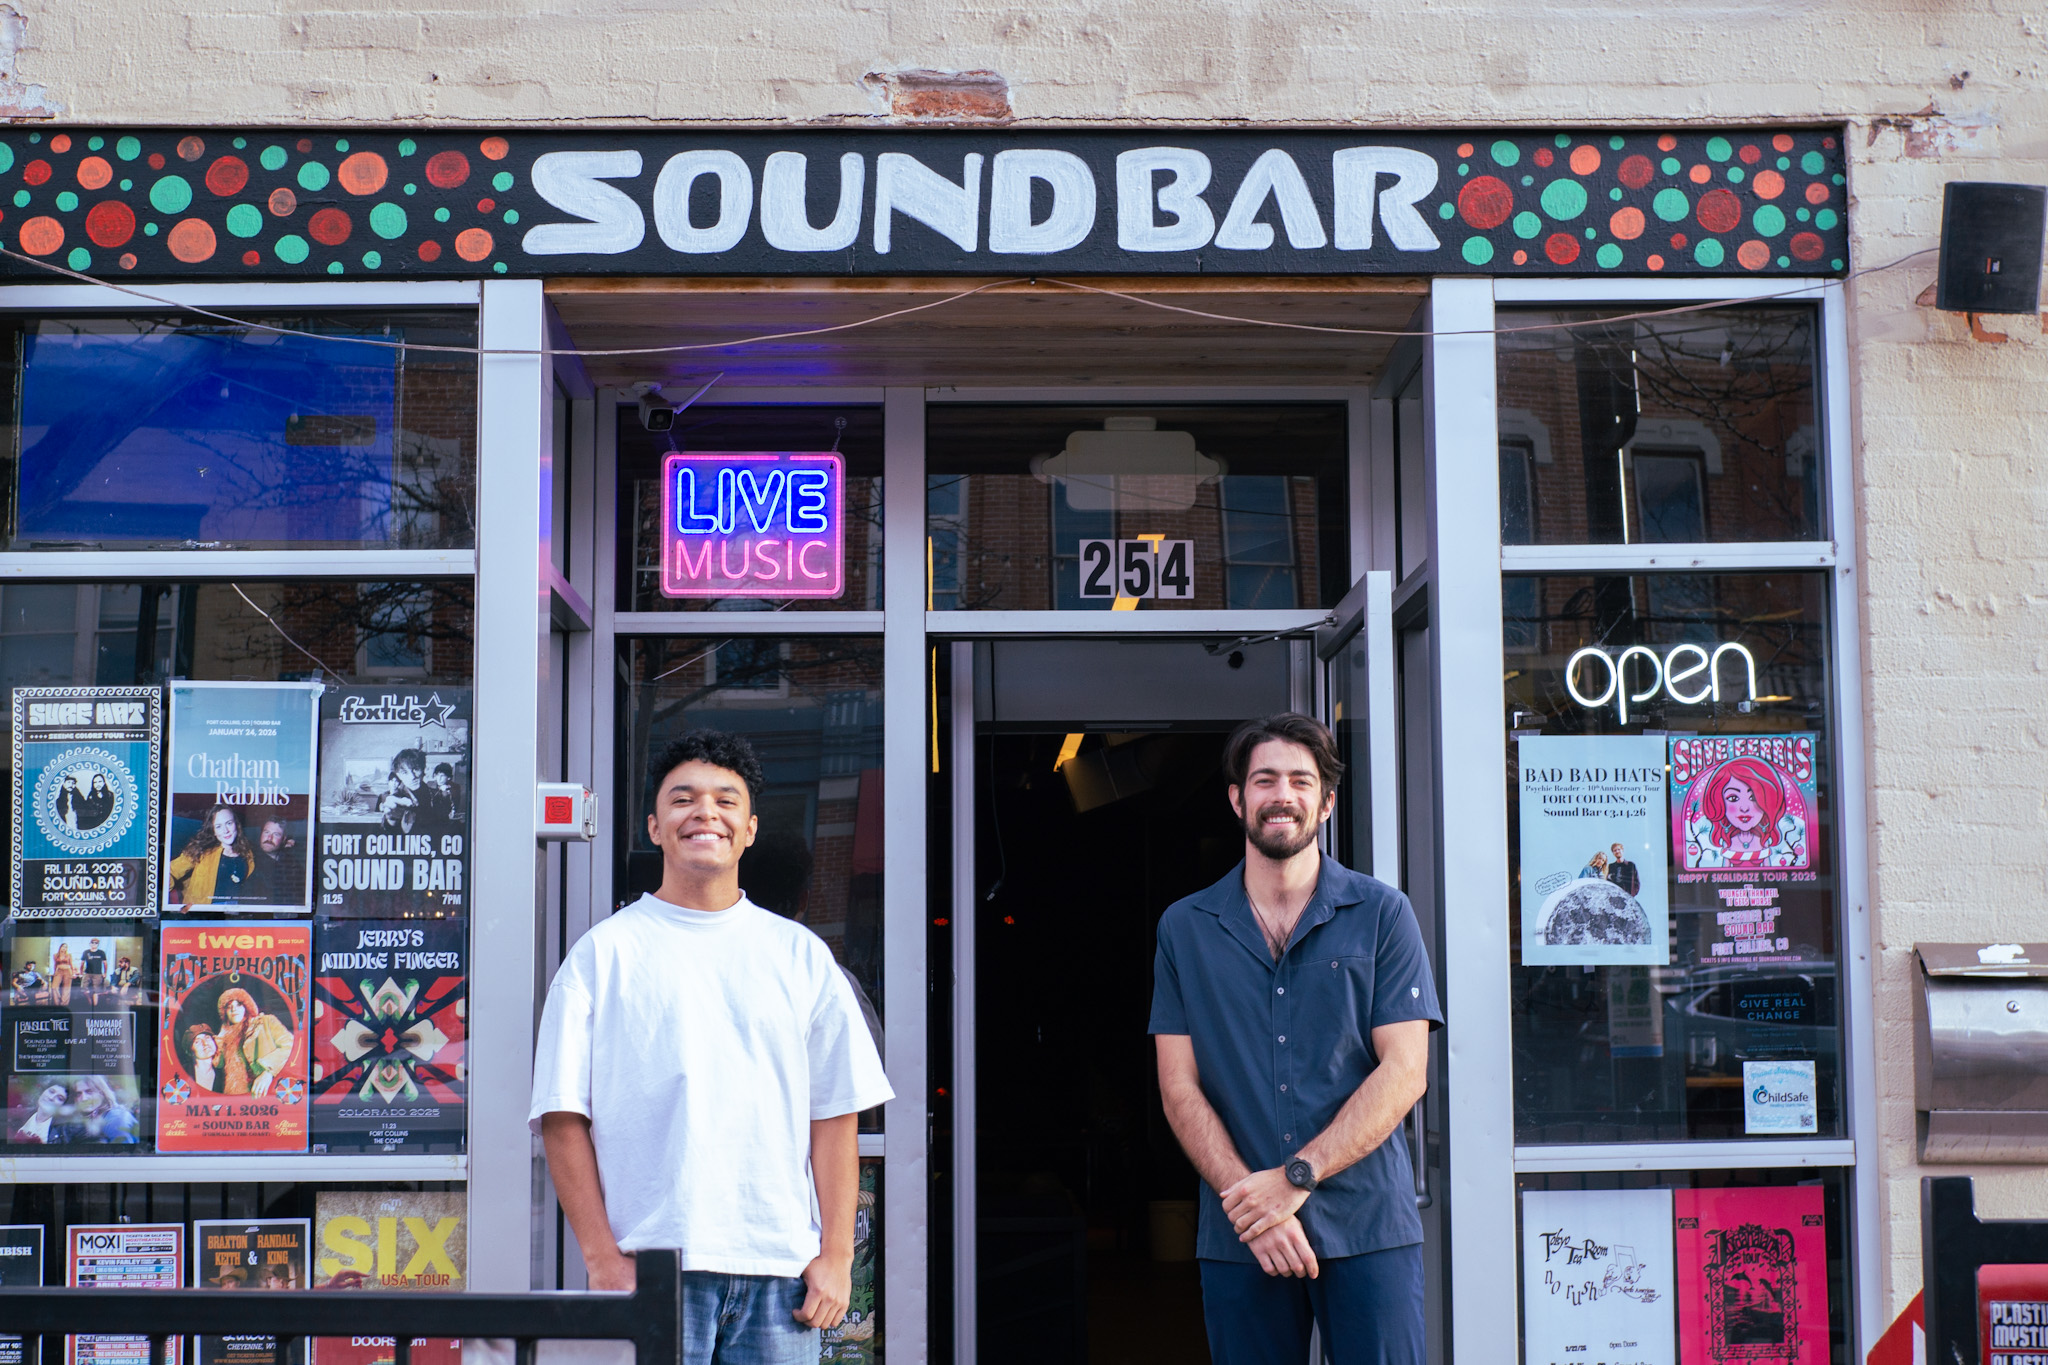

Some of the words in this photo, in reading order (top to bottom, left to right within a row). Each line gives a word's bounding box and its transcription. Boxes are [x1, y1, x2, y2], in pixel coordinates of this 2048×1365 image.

[522, 149, 1096, 255] SOUND
[1116, 146, 1441, 253] BAR
[676, 468, 829, 534] LIVE
[675, 539, 828, 581] MUSIC
[1082, 541, 1191, 597] 254
[1566, 642, 1757, 725] open
[96, 702, 145, 724] HAT
[342, 695, 421, 721] foxtide
[188, 753, 280, 779] Chatham
[1673, 738, 1728, 784] SAVE
[1733, 736, 1813, 782] FERRIS
[1525, 768, 1562, 782] BAD
[1570, 768, 1608, 782] BAD
[1614, 768, 1662, 782] HATS
[215, 780, 290, 806] Rabbits
[1525, 785, 1552, 793] Psychic
[1600, 785, 1641, 793] Anniversary
[1543, 795, 1572, 804] FORT
[1576, 795, 1629, 805] COLLINS,
[1630, 795, 1646, 804] CO
[1544, 807, 1578, 817] Sound
[1582, 808, 1602, 817] Bar
[323, 834, 361, 856] FORT
[366, 834, 436, 858] COLLINS,
[441, 834, 462, 855] CO
[92, 863, 124, 874] 2025
[323, 859, 404, 890] SOUND
[412, 858, 462, 890] BAR
[43, 876, 94, 890] SOUND
[98, 876, 124, 890] BAR
[1677, 874, 1709, 883] HAPPY
[1712, 872, 1759, 883] SKALIDAZE
[1763, 872, 1788, 881] TOUR
[1791, 872, 1816, 881] 2025
[42, 892, 65, 902] FORT
[108, 892, 126, 901] CO
[322, 894, 343, 905] 11.25
[442, 893, 461, 905] 7PM
[1719, 889, 1747, 898] YOUNGER
[1748, 888, 1764, 897] THAN
[1765, 888, 1779, 897] NEIL
[1726, 898, 1733, 906] IT
[1734, 898, 1749, 906] GETS
[1750, 898, 1772, 906] WORSE
[1717, 909, 1762, 925] DECEMBER
[1724, 923, 1754, 937] SOUND
[1756, 921, 1774, 934] BAR
[198, 932, 274, 949] twen
[356, 929, 424, 949] JERRY'S
[1712, 942, 1734, 956] FORT
[1735, 939, 1774, 954] COLLINS,
[1776, 937, 1789, 950] CO
[320, 952, 388, 972] MIDDLE
[394, 952, 459, 970] FINGER
[1740, 999, 1769, 1008] GIVE
[1775, 998, 1806, 1007] REAL
[1747, 1011, 1800, 1020] CHANGE
[86, 1019, 122, 1028] HANDMADE
[88, 1027, 120, 1036] MOMENTS
[1757, 1091, 1808, 1103] ChildSafe
[186, 1105, 222, 1116] MAY
[240, 1105, 278, 1116] 2026
[203, 1121, 243, 1130] SOUND
[246, 1121, 270, 1130] BAR
[80, 1235, 120, 1249] MOXI
[208, 1235, 248, 1249] BRAXTON
[257, 1234, 298, 1248] RANDALL
[320, 1216, 461, 1280] SIX
[1539, 1228, 1571, 1262] Tokyo
[0, 1246, 32, 1256] BISH
[215, 1252, 240, 1265] KEITH
[248, 1251, 257, 1265] &
[267, 1251, 288, 1264] KING
[1564, 1246, 1583, 1265] Tea
[1583, 1239, 1608, 1260] Room
[1743, 1251, 1760, 1264] tour
[382, 1274, 408, 1286] USA
[415, 1274, 450, 1286] TOUR
[1545, 1270, 1561, 1295] no
[1566, 1281, 1598, 1306] rush
[1992, 1303, 2048, 1325] PLASTI
[1994, 1325, 2048, 1347] MYSTI
[1609, 1342, 1622, 1350] Open
